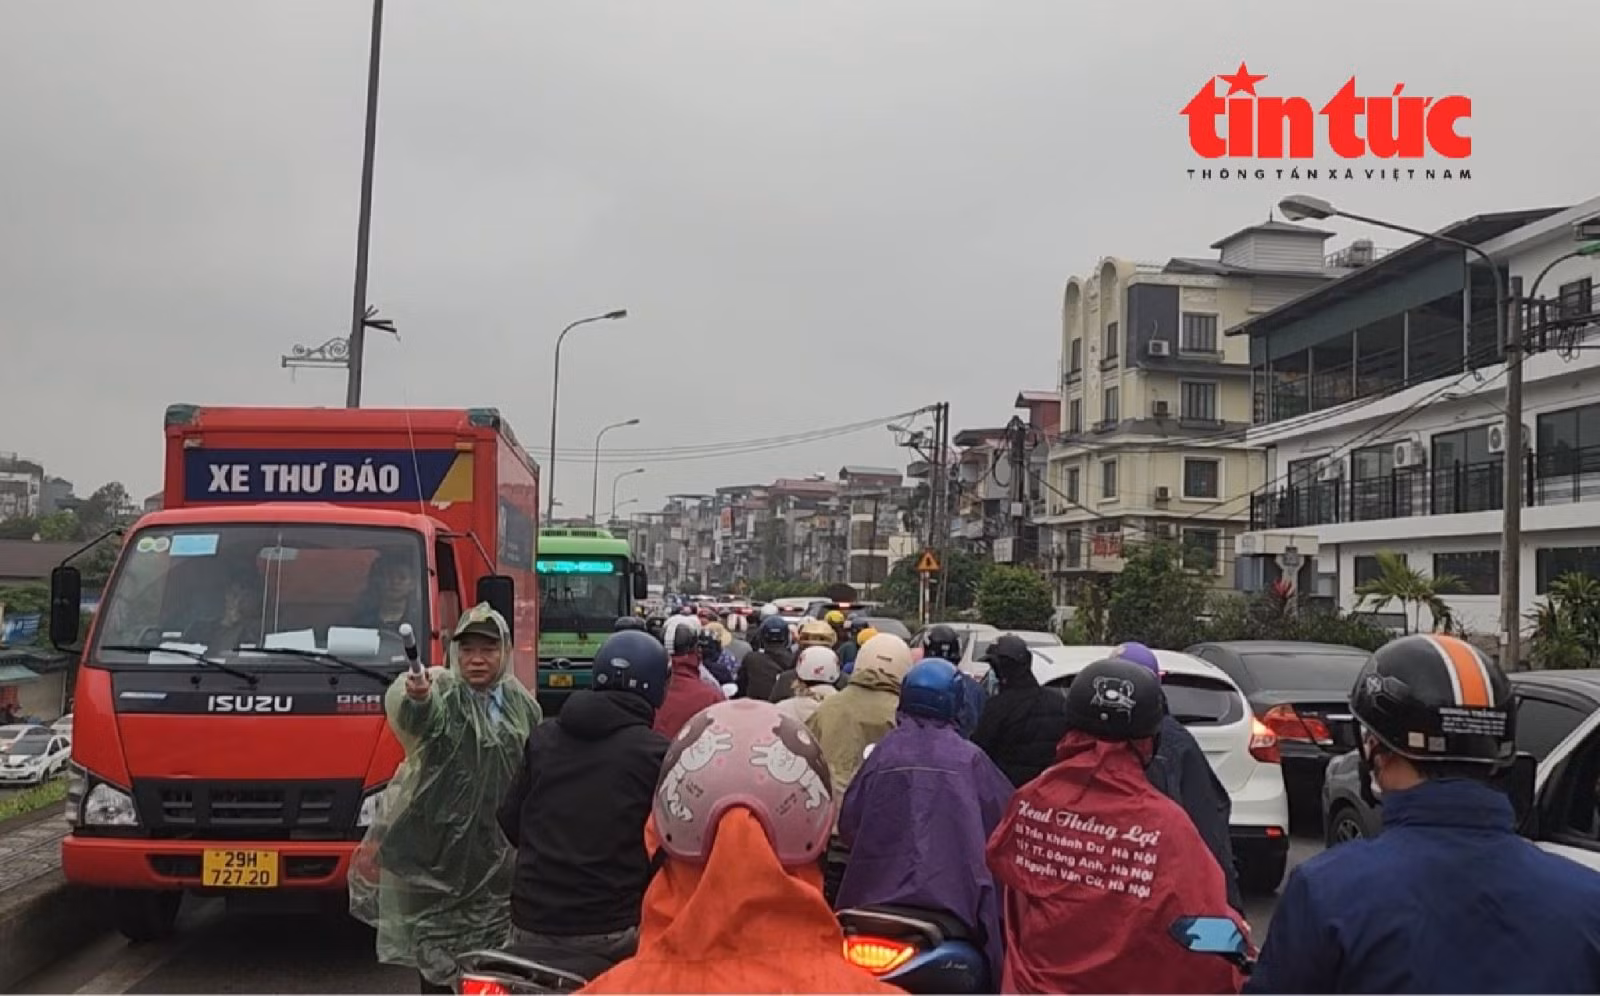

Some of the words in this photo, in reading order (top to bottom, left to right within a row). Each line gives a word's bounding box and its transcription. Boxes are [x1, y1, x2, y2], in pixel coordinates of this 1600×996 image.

[208, 464, 250, 493] XE
[260, 461, 327, 493] THƯ
[333, 457, 400, 493] BÁO
[207, 695, 293, 712] ISUZU
[1056, 811, 1119, 840] Thắng
[1121, 825, 1161, 848] Lợi
[224, 851, 258, 868] 29H
[1112, 847, 1129, 860] Hà
[1134, 852, 1158, 866] Nội
[211, 868, 270, 886] 727.20
[1078, 858, 1107, 873] Anh,
[1110, 863, 1129, 877] Hà
[1131, 867, 1154, 883] Nội
[1108, 879, 1125, 892] Hà
[1128, 884, 1151, 899] Nội
